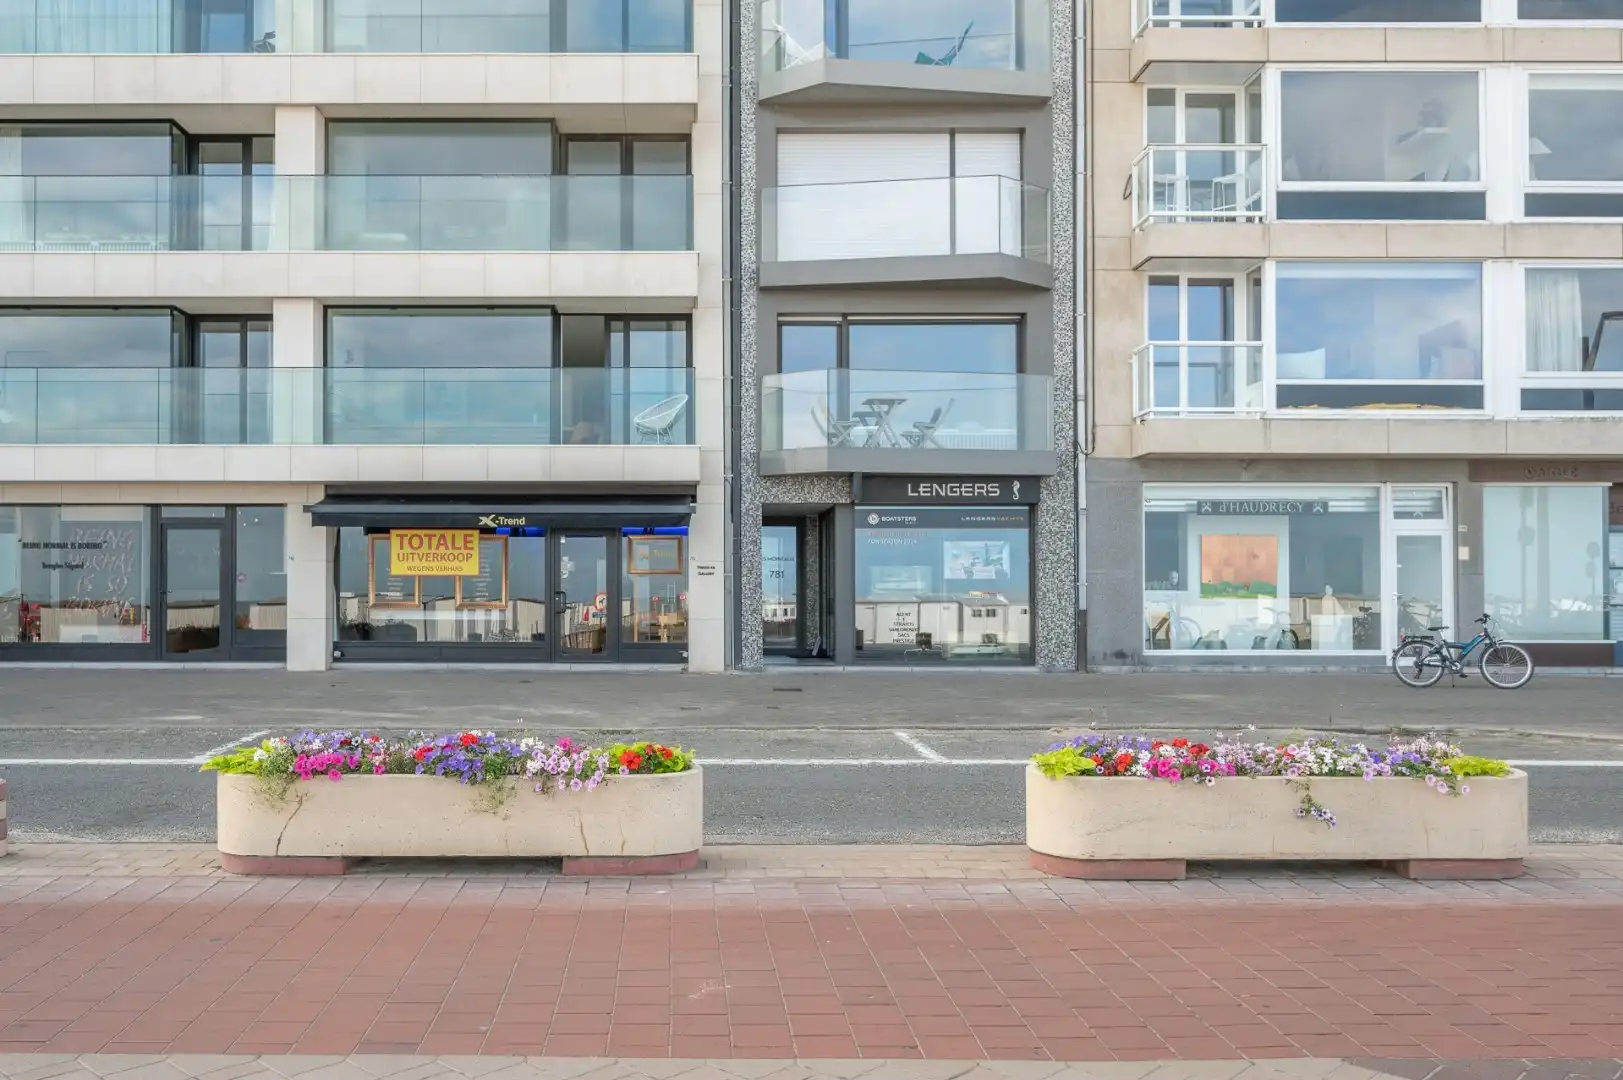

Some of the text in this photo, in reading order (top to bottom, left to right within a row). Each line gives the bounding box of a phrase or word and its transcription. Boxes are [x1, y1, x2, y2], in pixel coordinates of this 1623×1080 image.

[907, 483, 1000, 497] LENGERS
[1219, 501, 1305, 513] d'HAUDRECY
[478, 514, 526, 527] X-Trend
[395, 533, 475, 551] TOTALE
[396, 552, 473, 563] UITVERKOOP
[769, 570, 784, 579] 781
